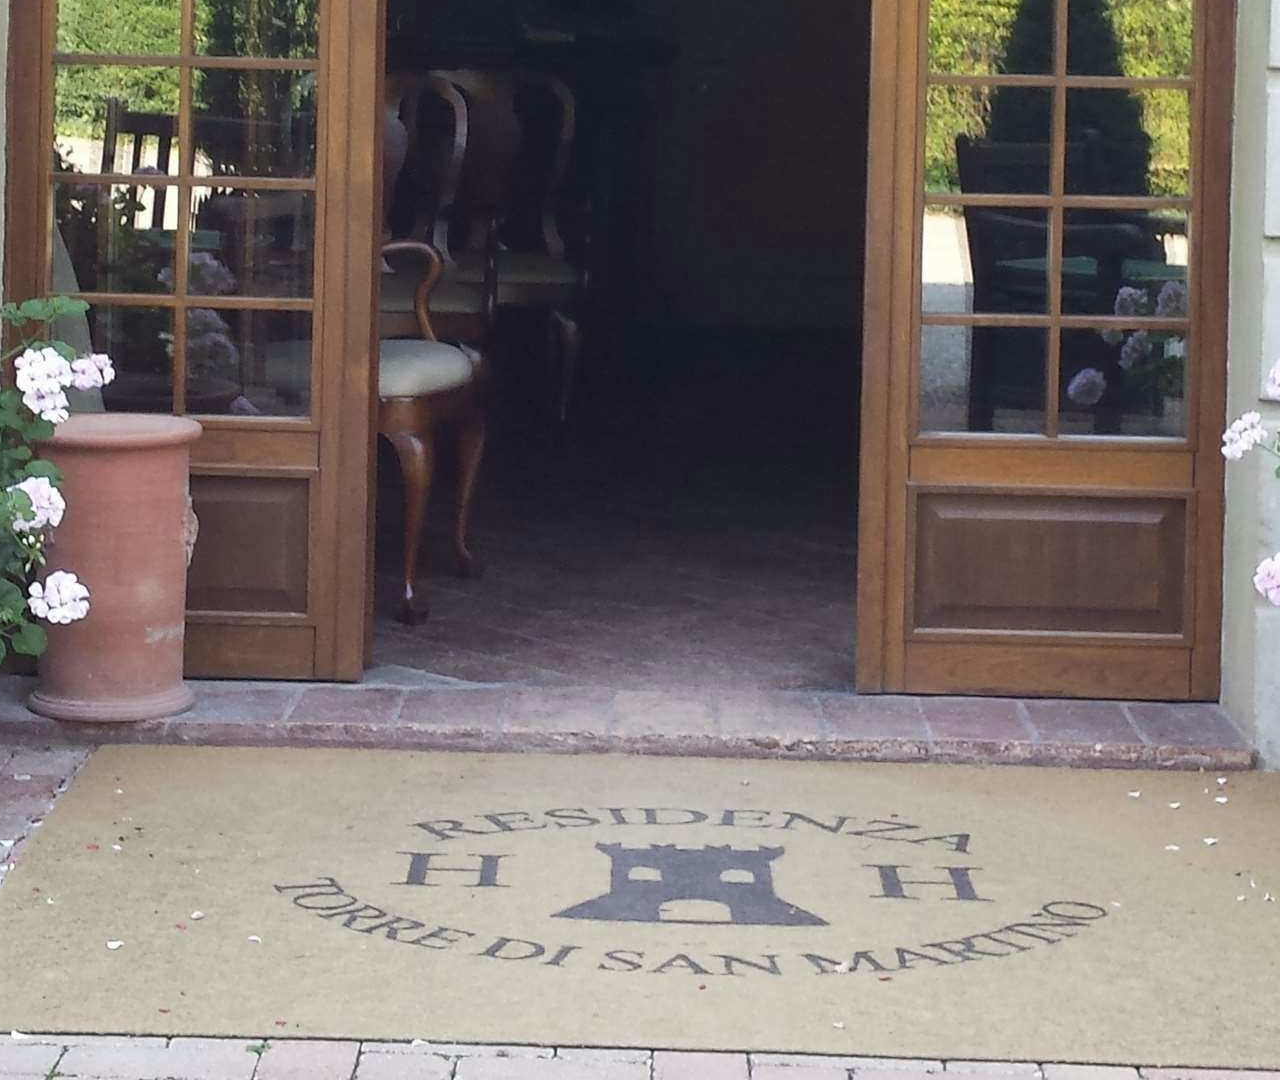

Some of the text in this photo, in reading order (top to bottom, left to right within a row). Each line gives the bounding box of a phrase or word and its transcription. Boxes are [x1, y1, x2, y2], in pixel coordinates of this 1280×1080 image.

[408, 807, 970, 855] RESIDENZA
[389, 850, 518, 888] H
[861, 863, 995, 902] H
[273, 876, 1108, 977] TORRE DI SAN MARTINO
